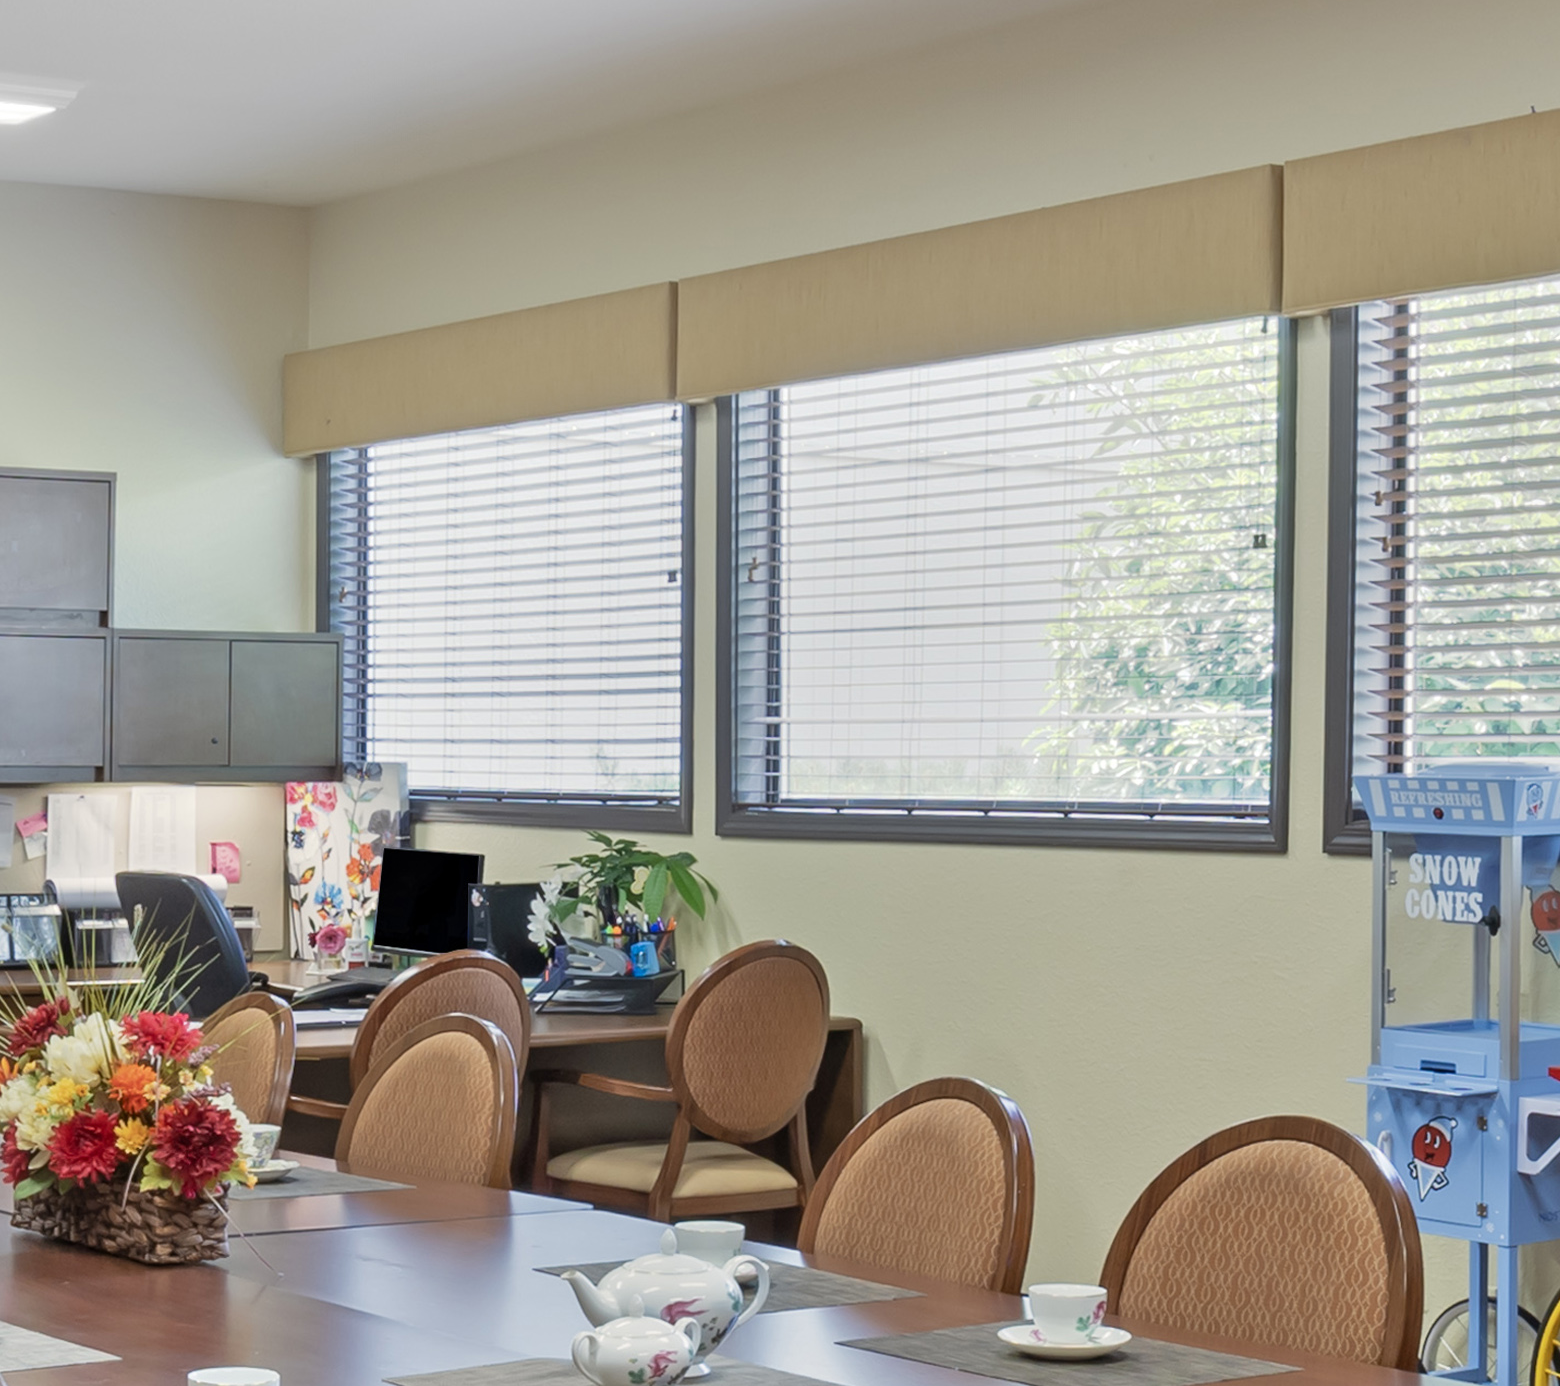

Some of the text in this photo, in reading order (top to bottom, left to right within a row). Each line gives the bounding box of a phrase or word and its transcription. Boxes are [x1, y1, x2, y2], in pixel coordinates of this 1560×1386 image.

[1389, 790, 1483, 808] REFRESHING
[1408, 853, 1482, 887] SNOW
[1405, 889, 1484, 924] CONES
